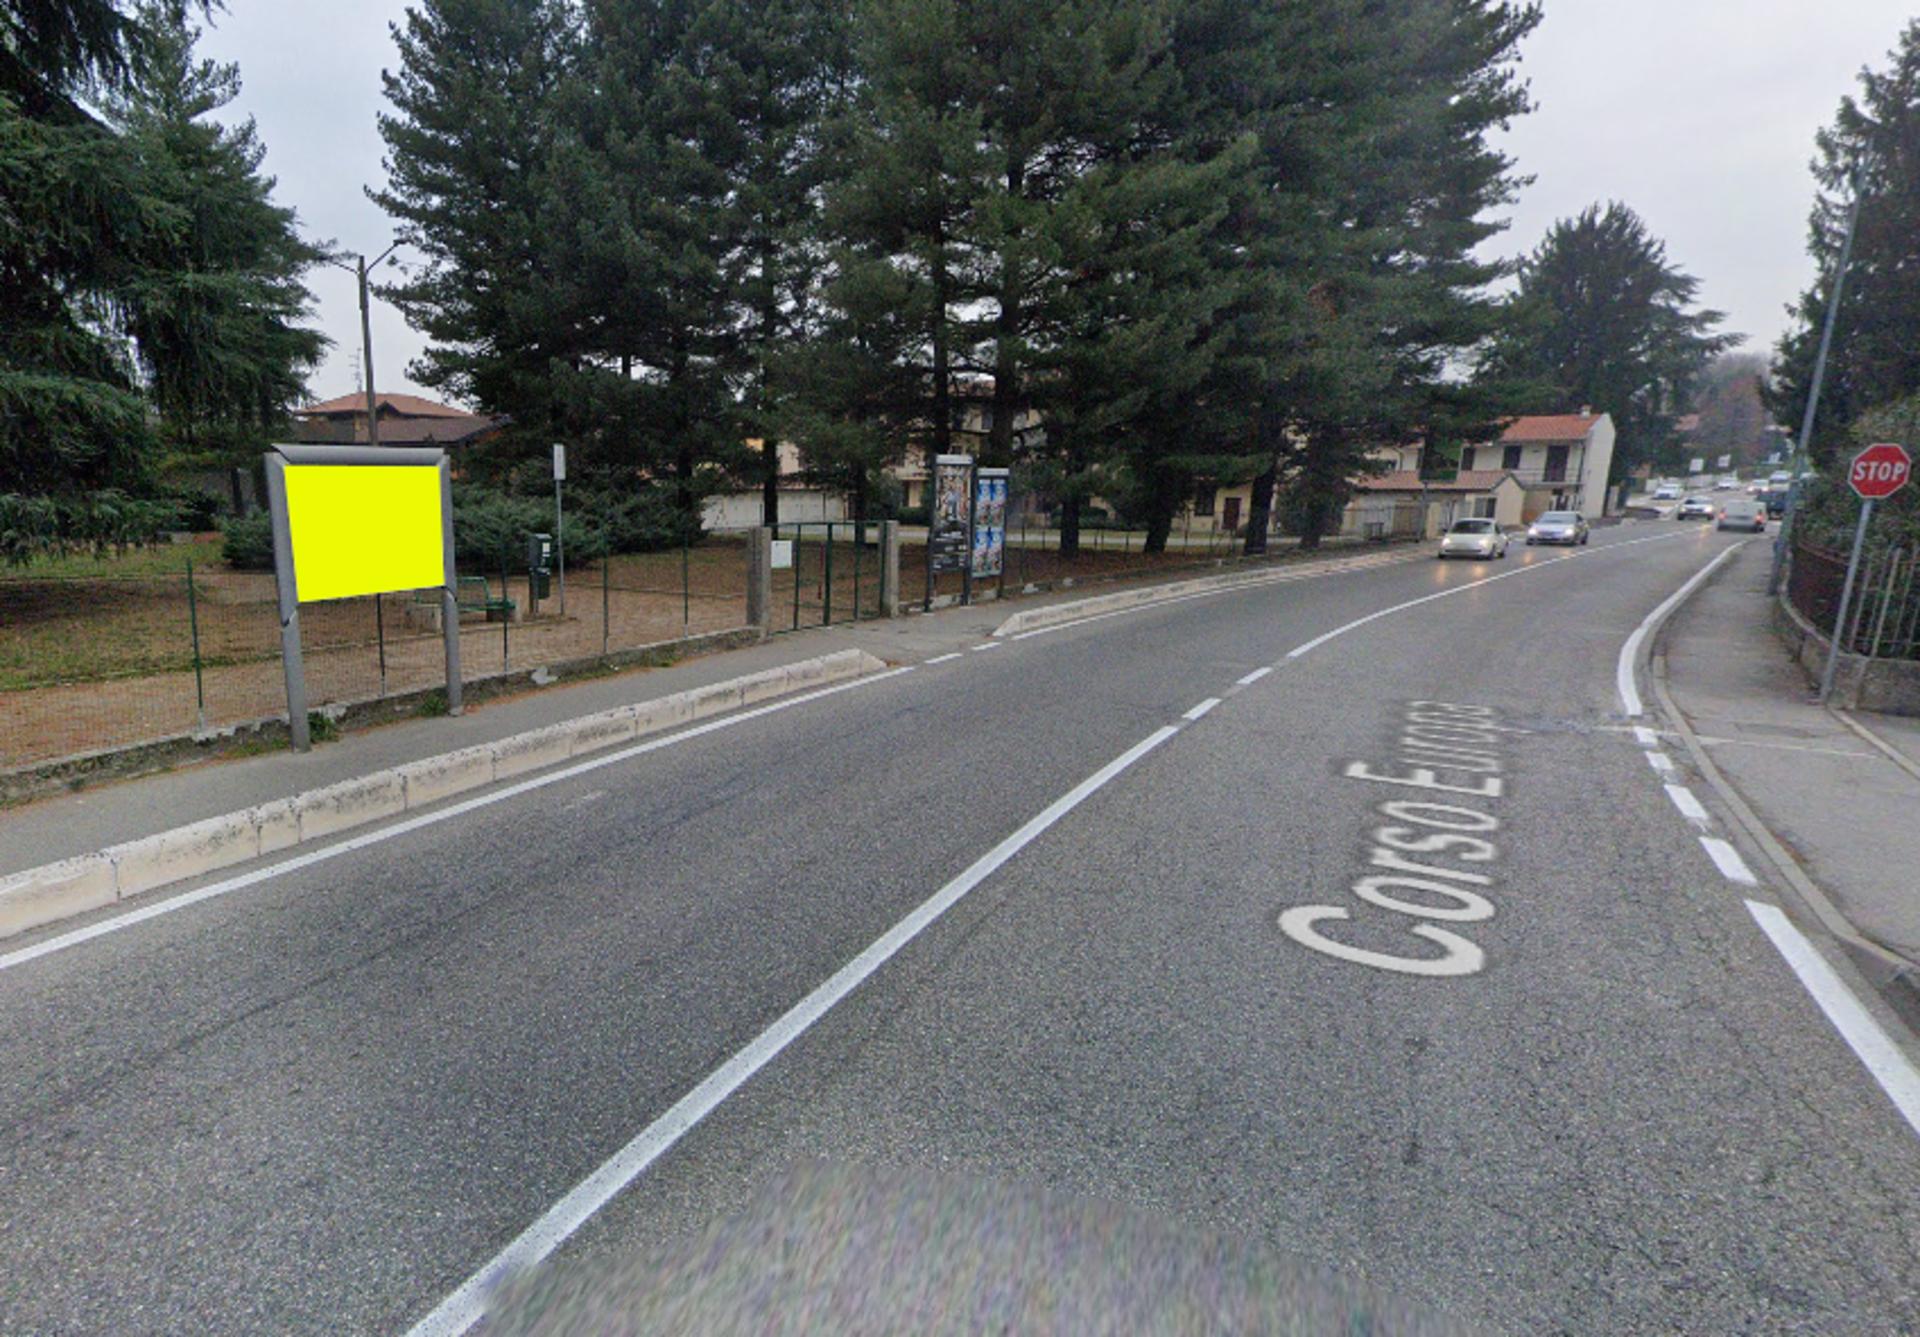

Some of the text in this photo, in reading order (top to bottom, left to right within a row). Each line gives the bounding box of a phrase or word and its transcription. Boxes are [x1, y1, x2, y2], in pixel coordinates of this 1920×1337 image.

[1854, 461, 1905, 481] STOP
[1277, 701, 1502, 976] Corso Europa
